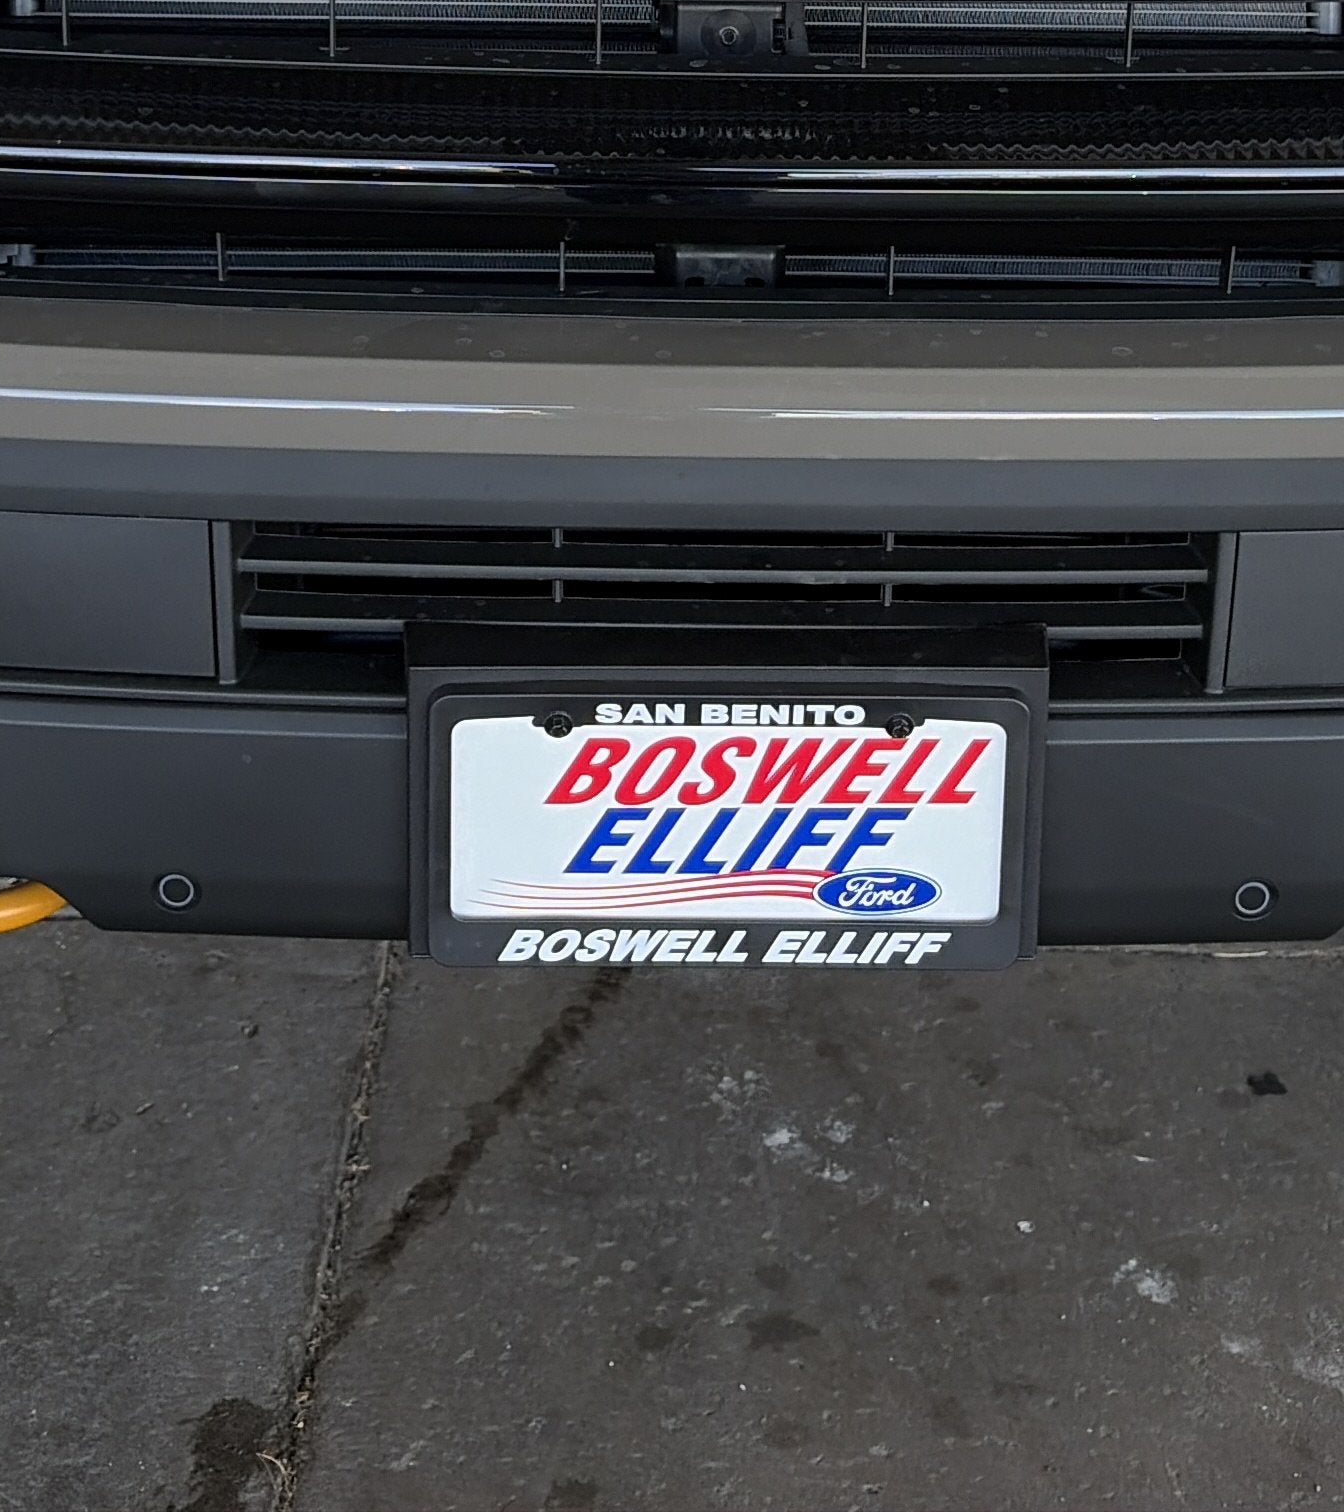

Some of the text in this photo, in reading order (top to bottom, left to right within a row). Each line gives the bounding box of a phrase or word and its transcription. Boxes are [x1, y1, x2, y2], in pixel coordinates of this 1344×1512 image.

[595, 703, 866, 725] SAN BENITO
[544, 737, 992, 804] BOSWELL
[564, 808, 913, 873] ELLIFF
[837, 876, 917, 907] Ford
[497, 929, 952, 964] BOSWELL ELLIFF
